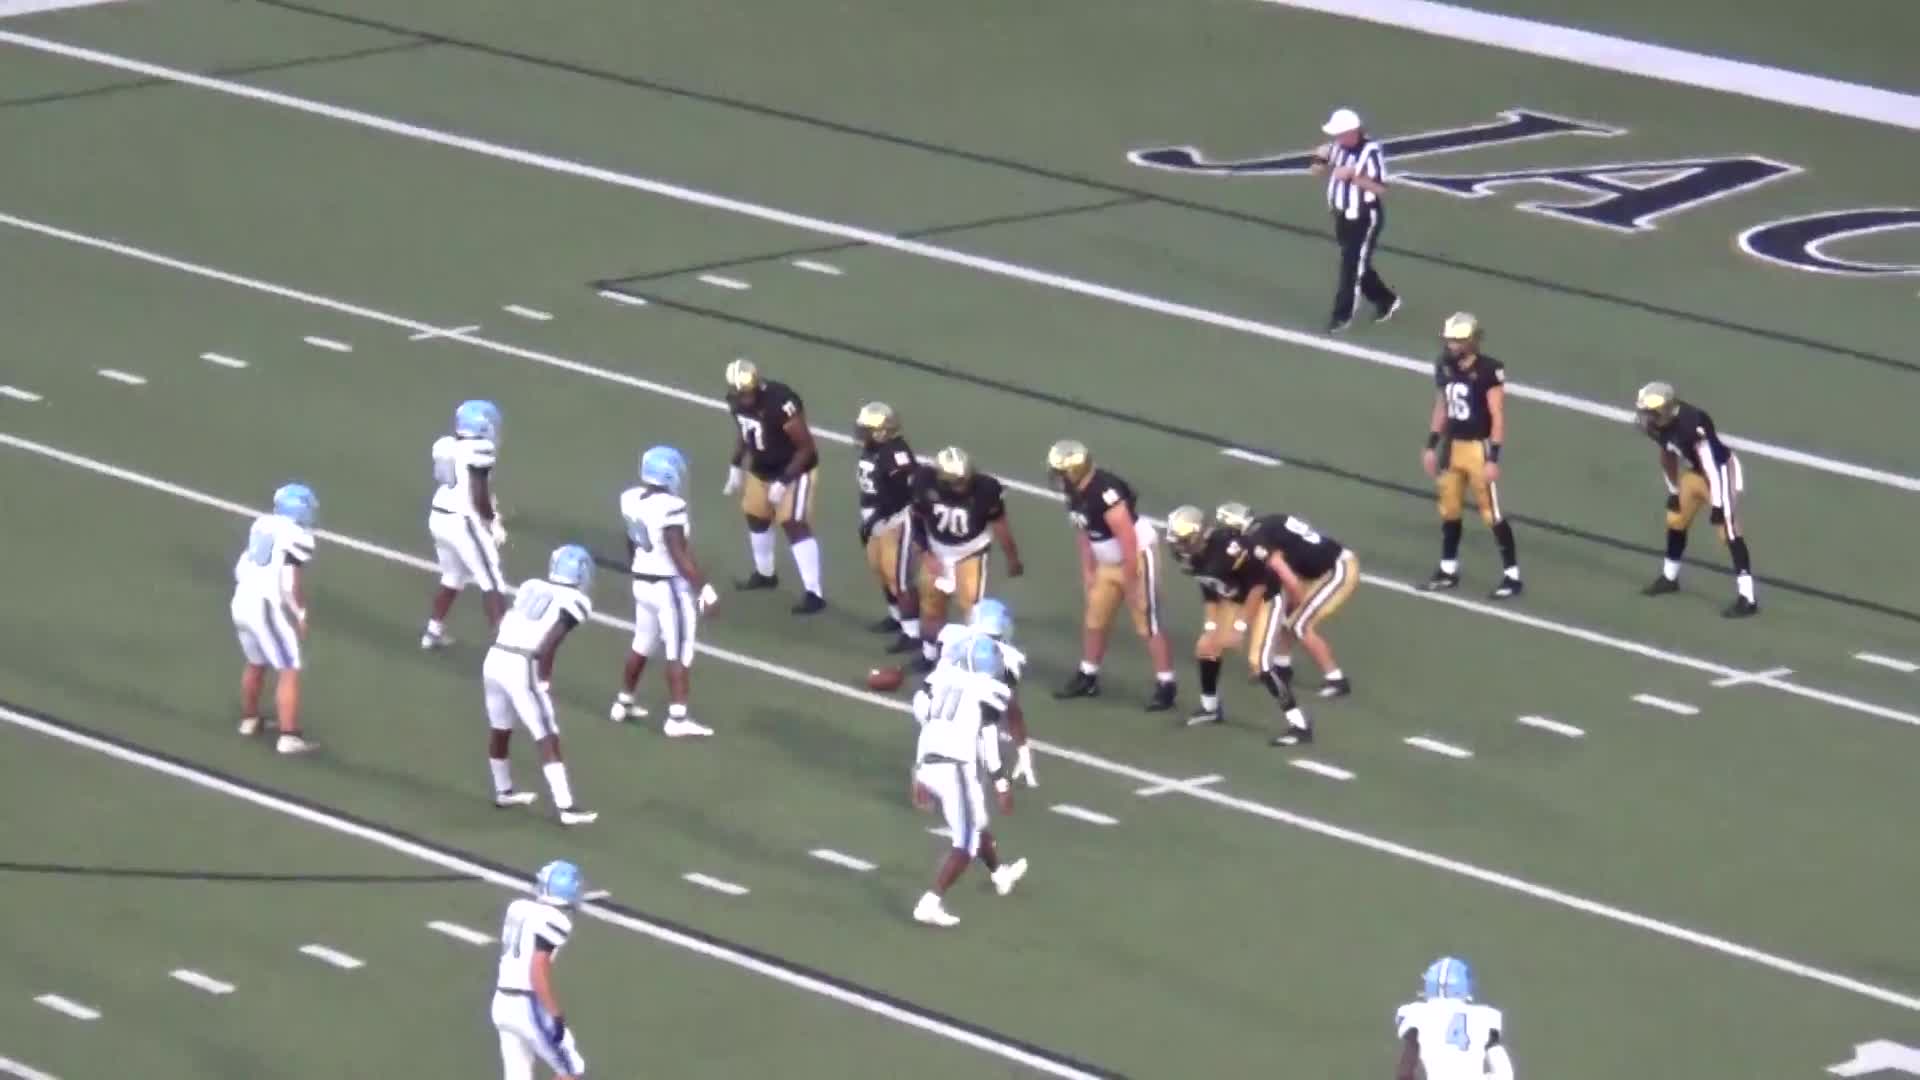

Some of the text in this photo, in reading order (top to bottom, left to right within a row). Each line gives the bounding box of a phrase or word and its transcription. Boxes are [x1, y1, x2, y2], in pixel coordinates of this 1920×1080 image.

[1445, 382, 1471, 421] 16
[737, 414, 765, 451] 77
[932, 503, 969, 537] 70
[1445, 1012, 1471, 1052] 4
